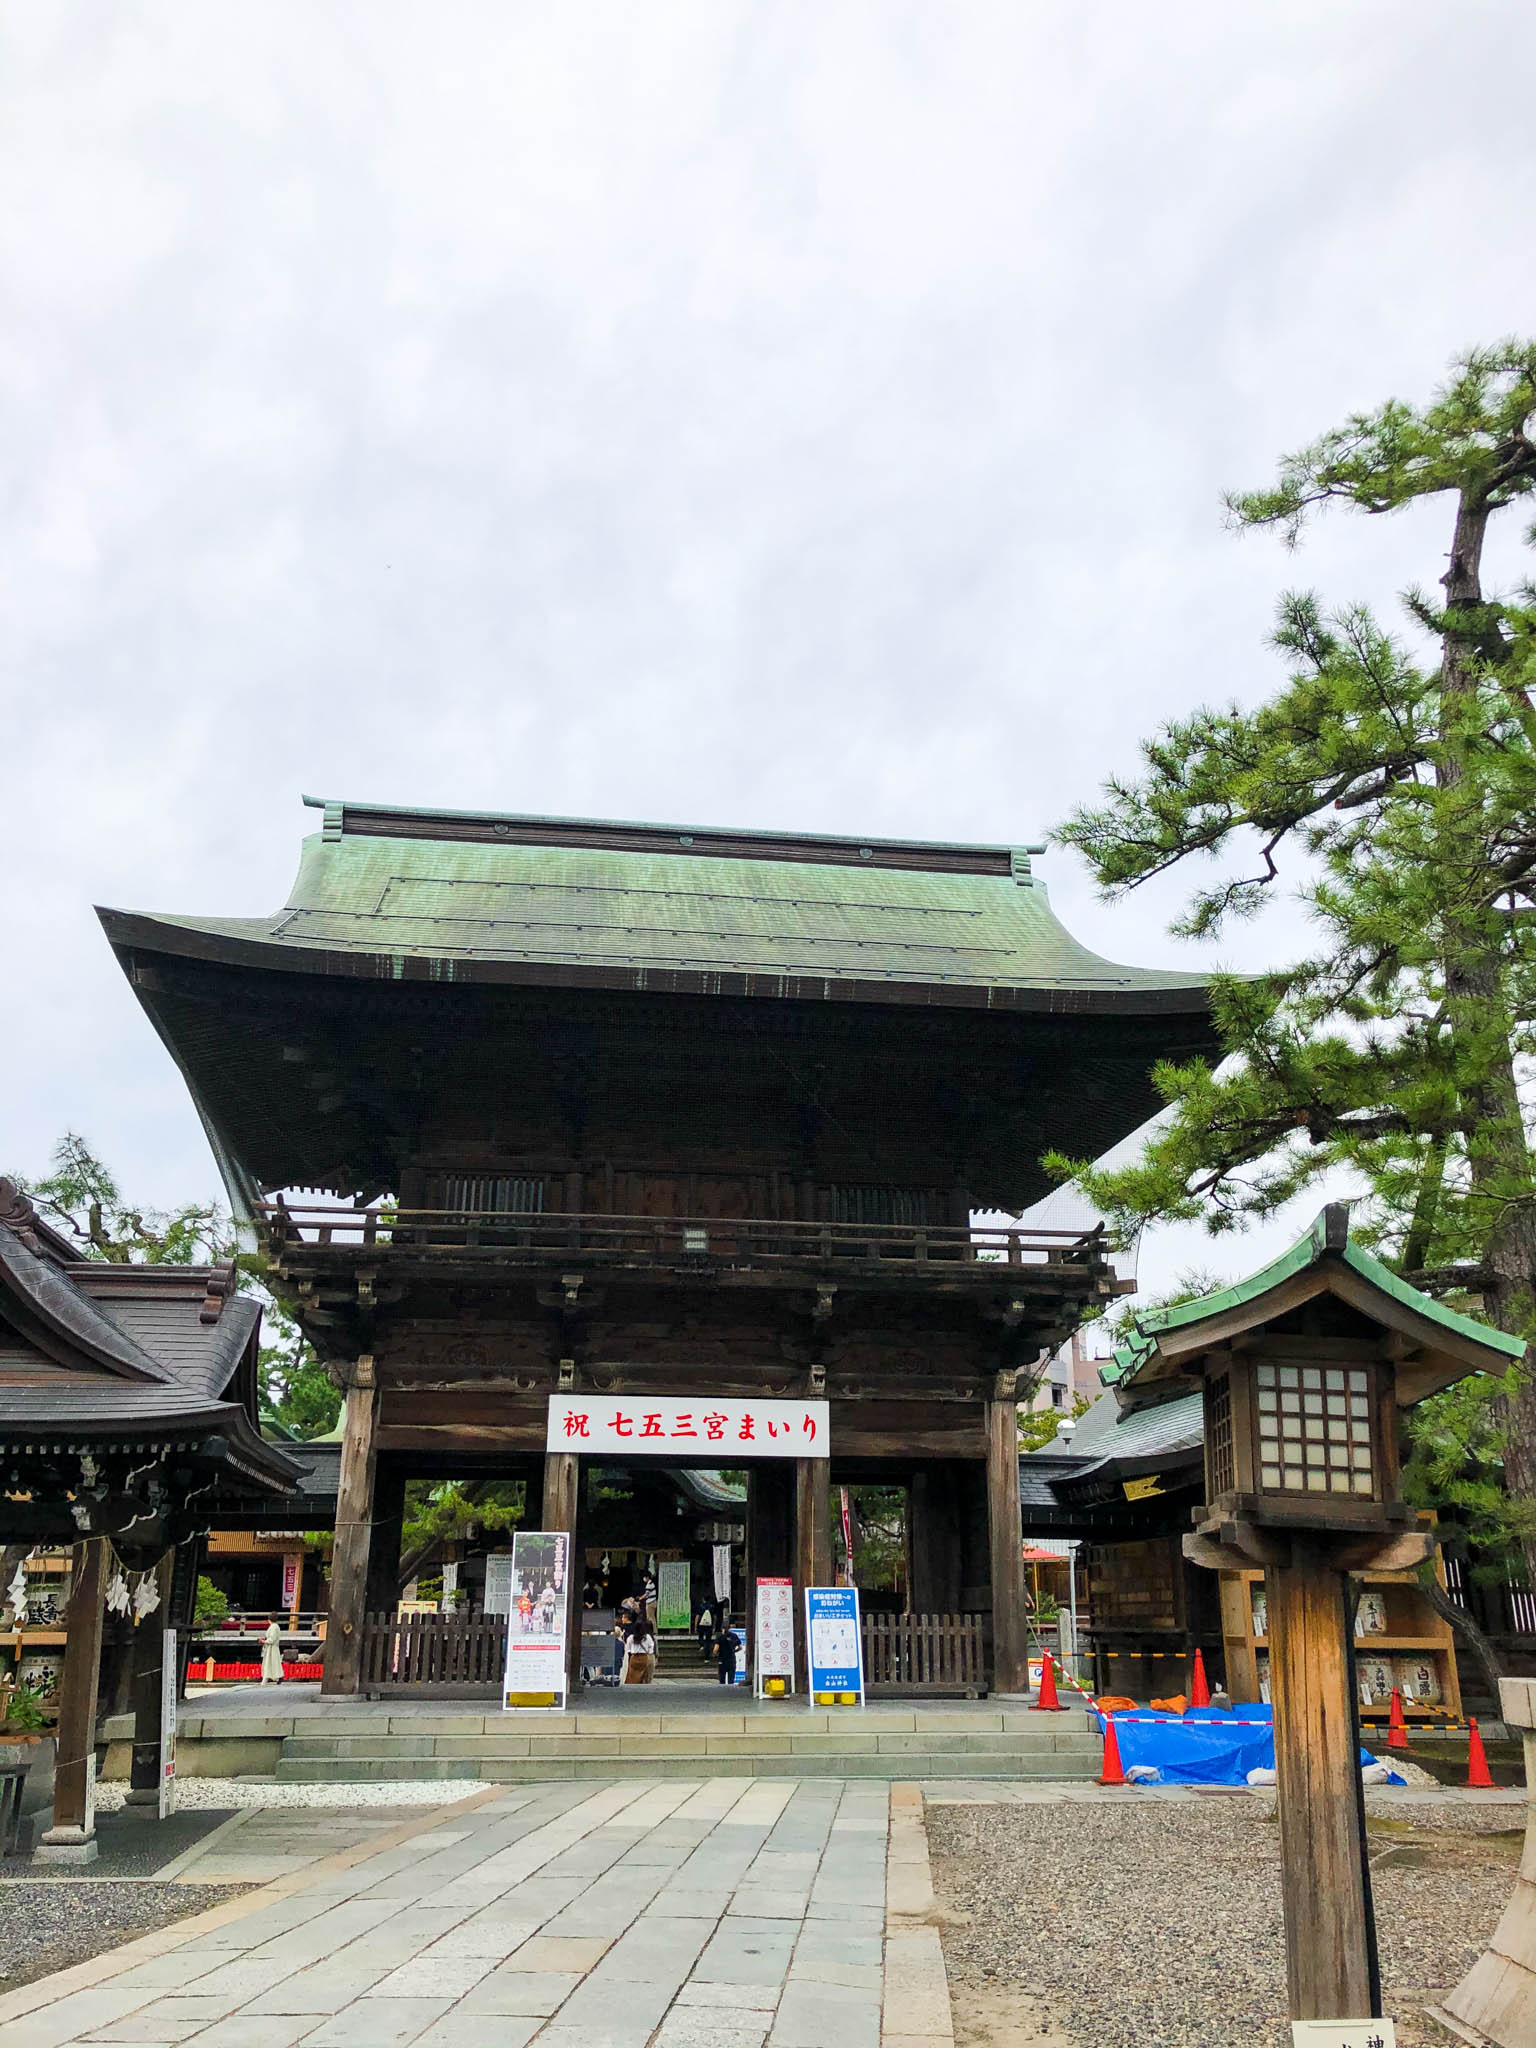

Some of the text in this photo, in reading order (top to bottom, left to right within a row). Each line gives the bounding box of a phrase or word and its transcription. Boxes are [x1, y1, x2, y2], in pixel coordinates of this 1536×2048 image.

[563, 1410, 817, 1442] 祝 七五三宮まいり
